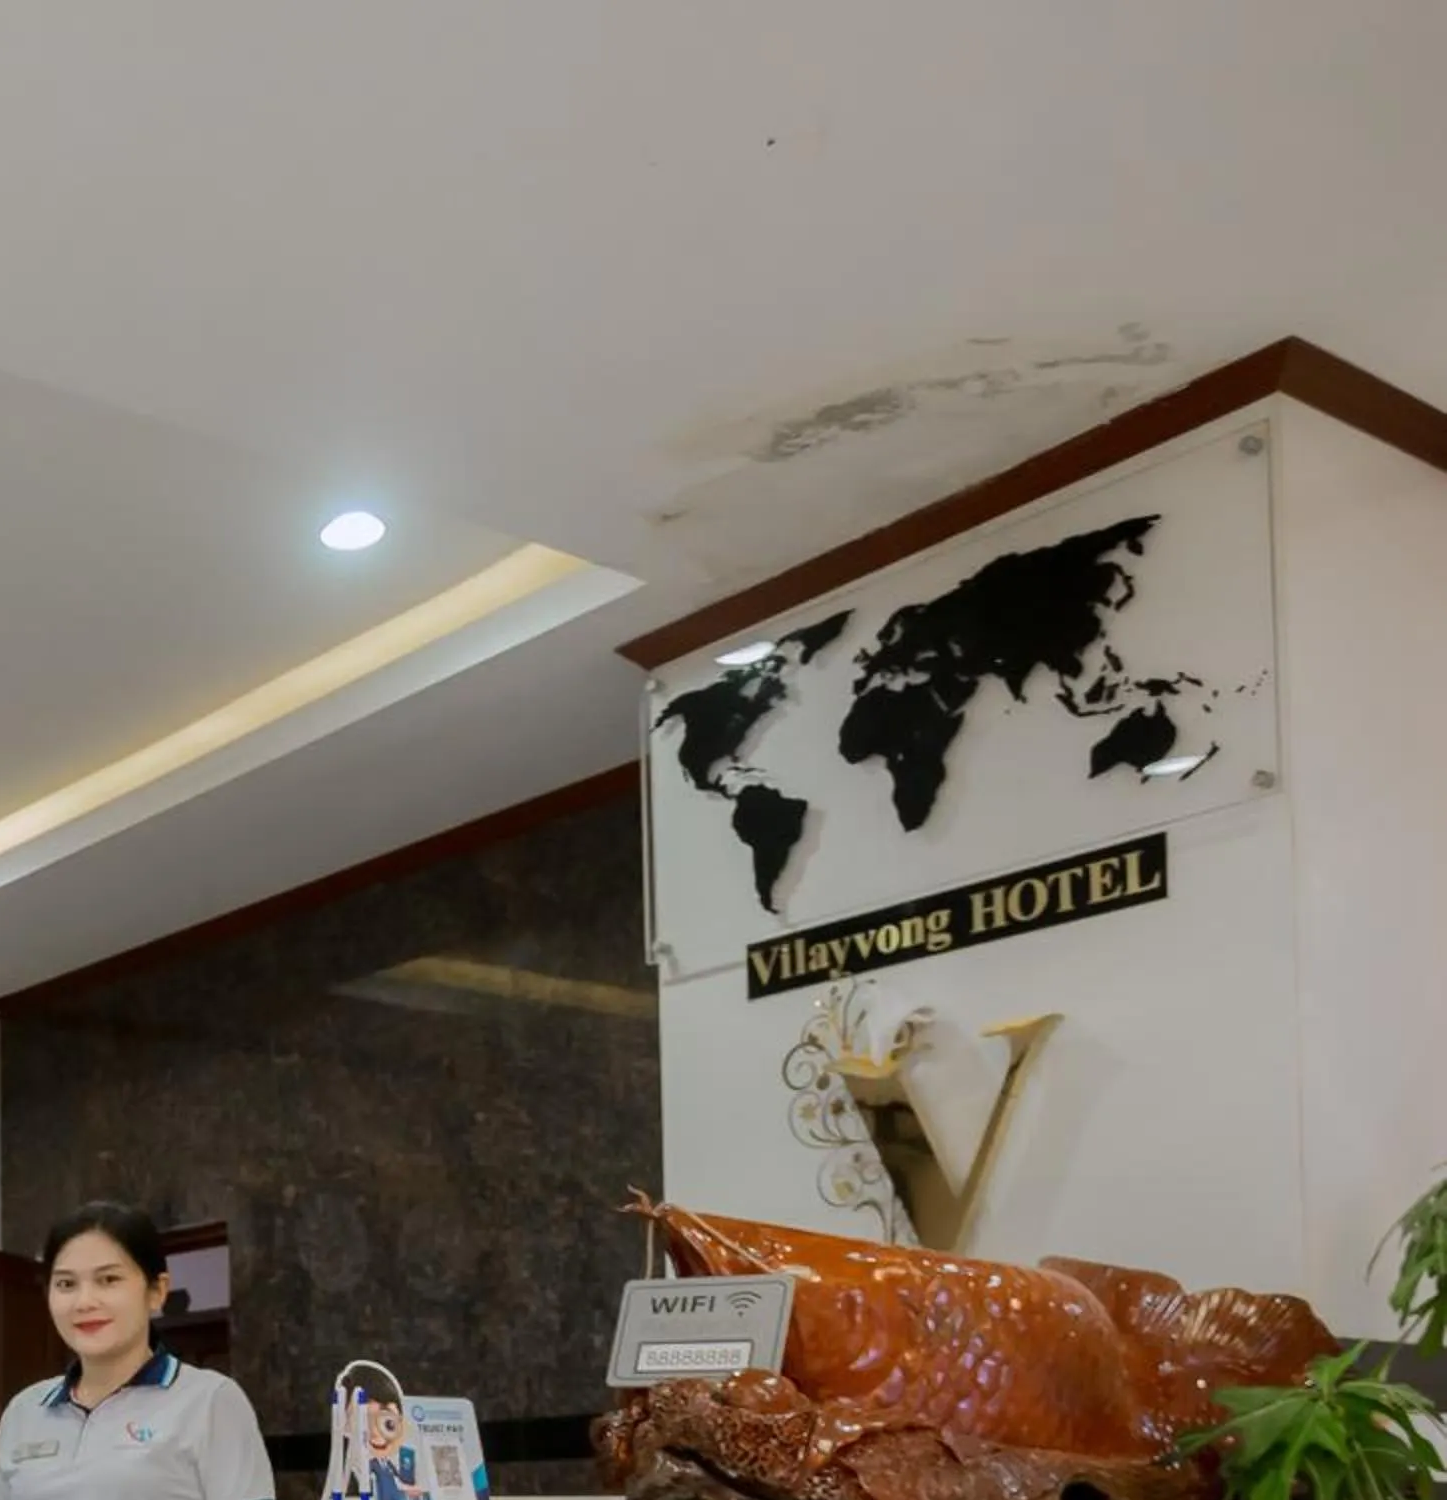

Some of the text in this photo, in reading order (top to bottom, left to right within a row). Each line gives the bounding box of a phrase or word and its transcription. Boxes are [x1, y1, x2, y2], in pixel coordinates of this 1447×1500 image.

[749, 850, 1162, 987] Vilayvong HOTEL
[651, 1295, 717, 1315] WIFI
